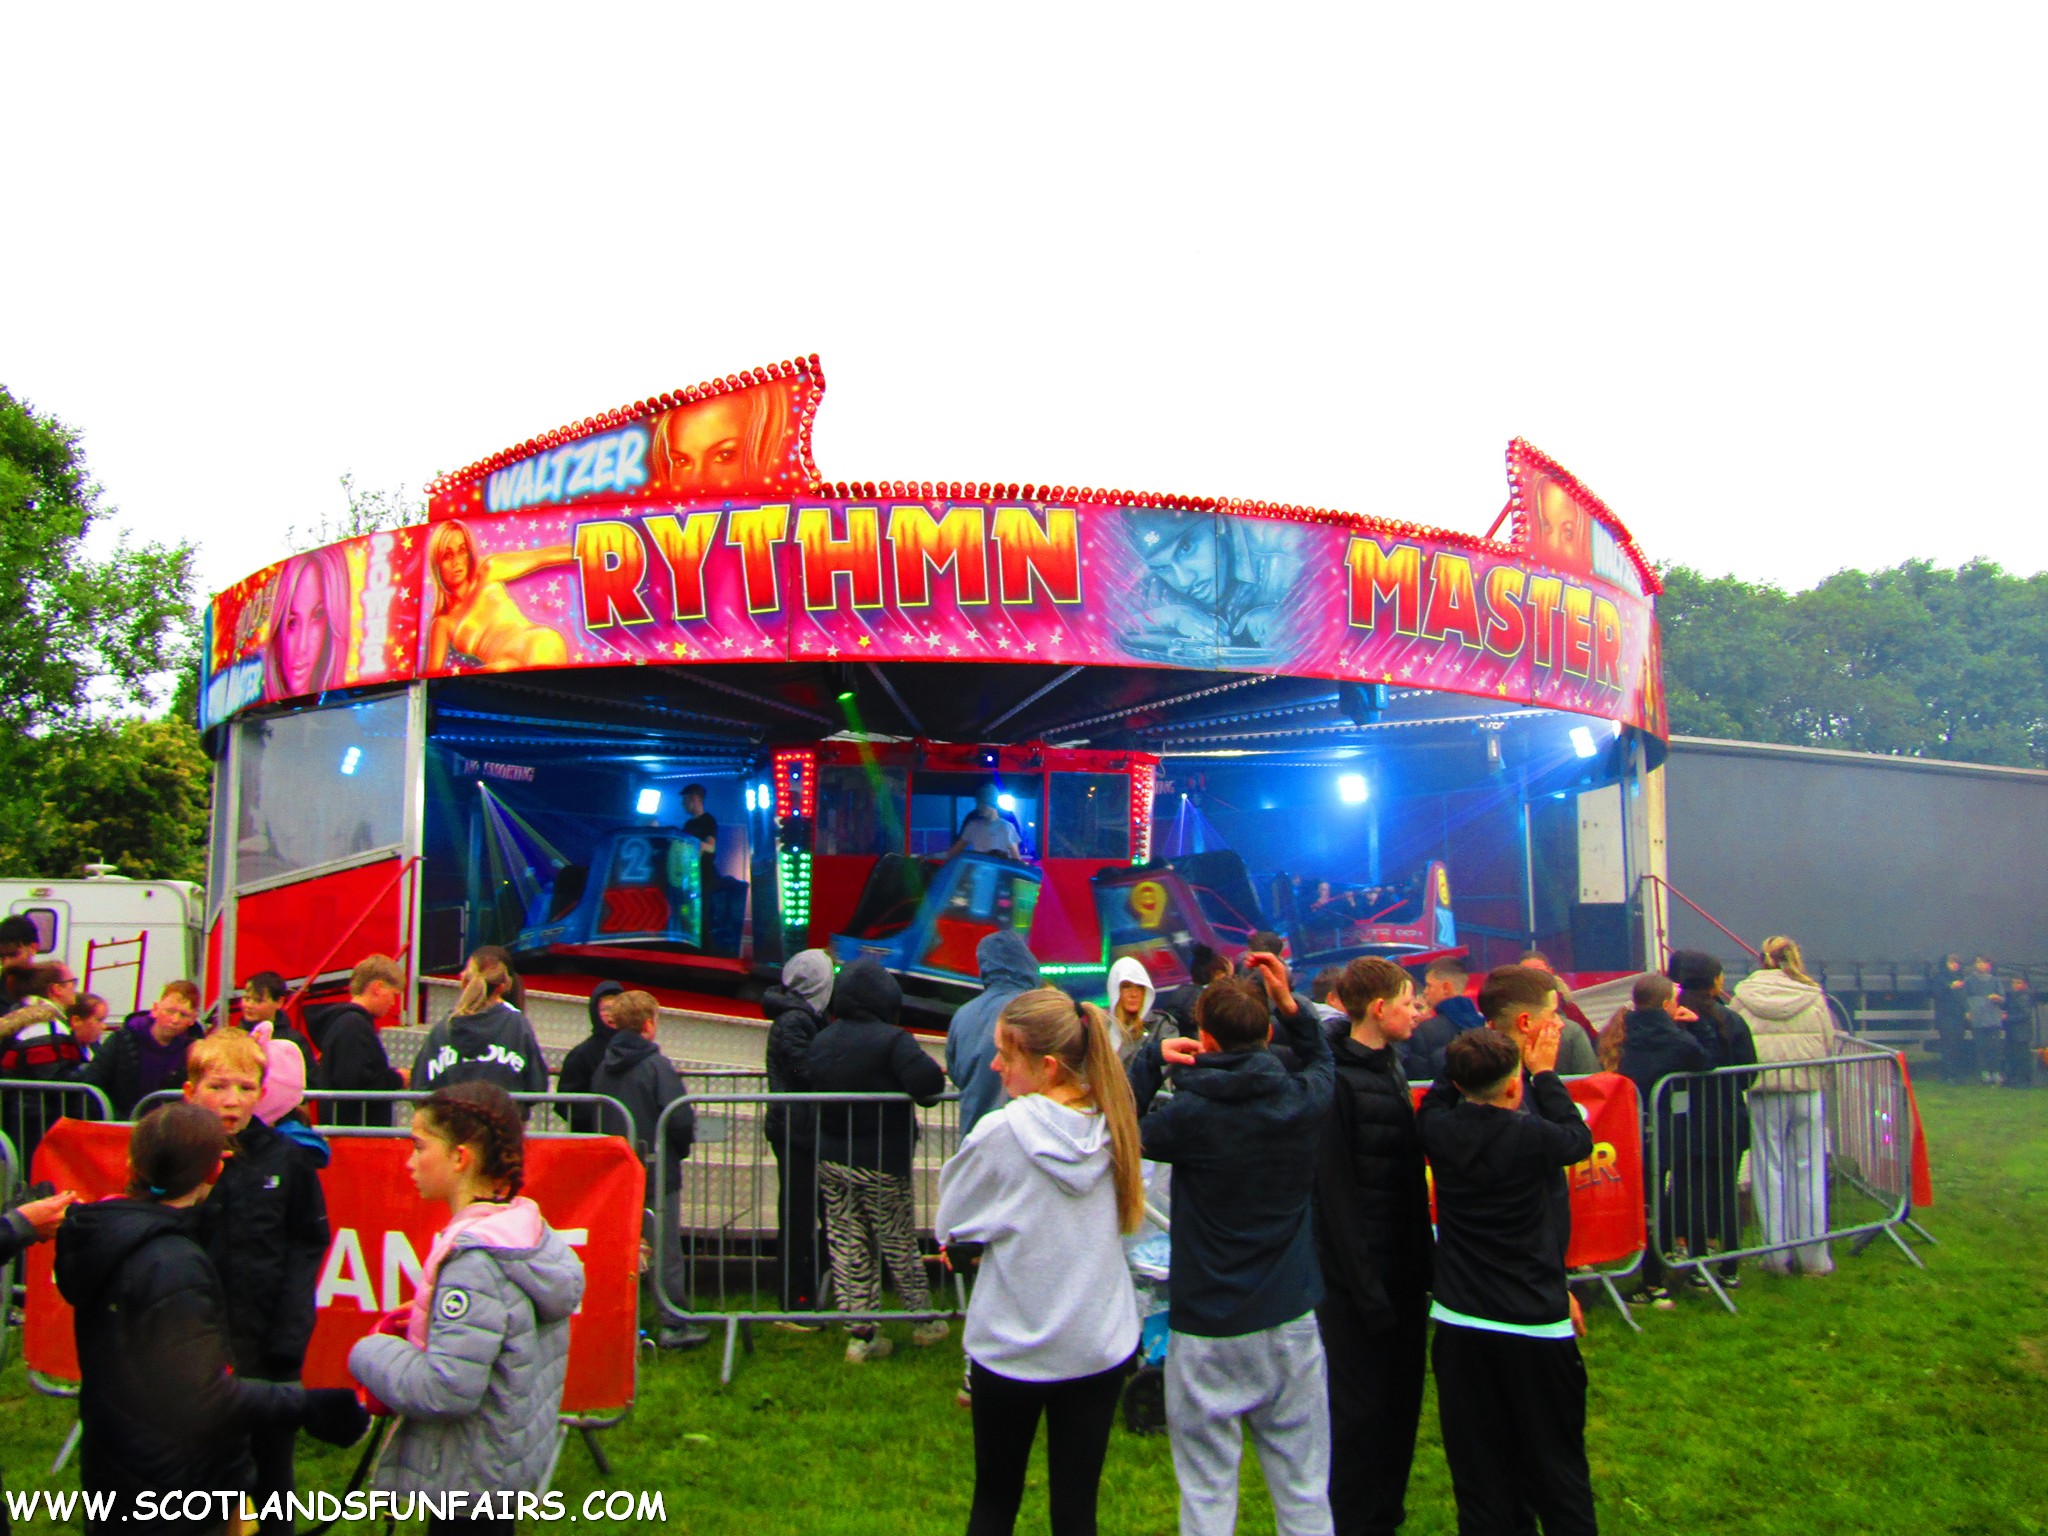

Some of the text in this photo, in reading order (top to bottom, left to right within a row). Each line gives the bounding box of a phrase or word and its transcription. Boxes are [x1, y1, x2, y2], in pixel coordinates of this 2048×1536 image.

[486, 427, 646, 512] WALTZER
[572, 504, 1082, 630] RYTHMN
[1345, 537, 1623, 692] MASTER
[619, 838, 654, 883] 2
